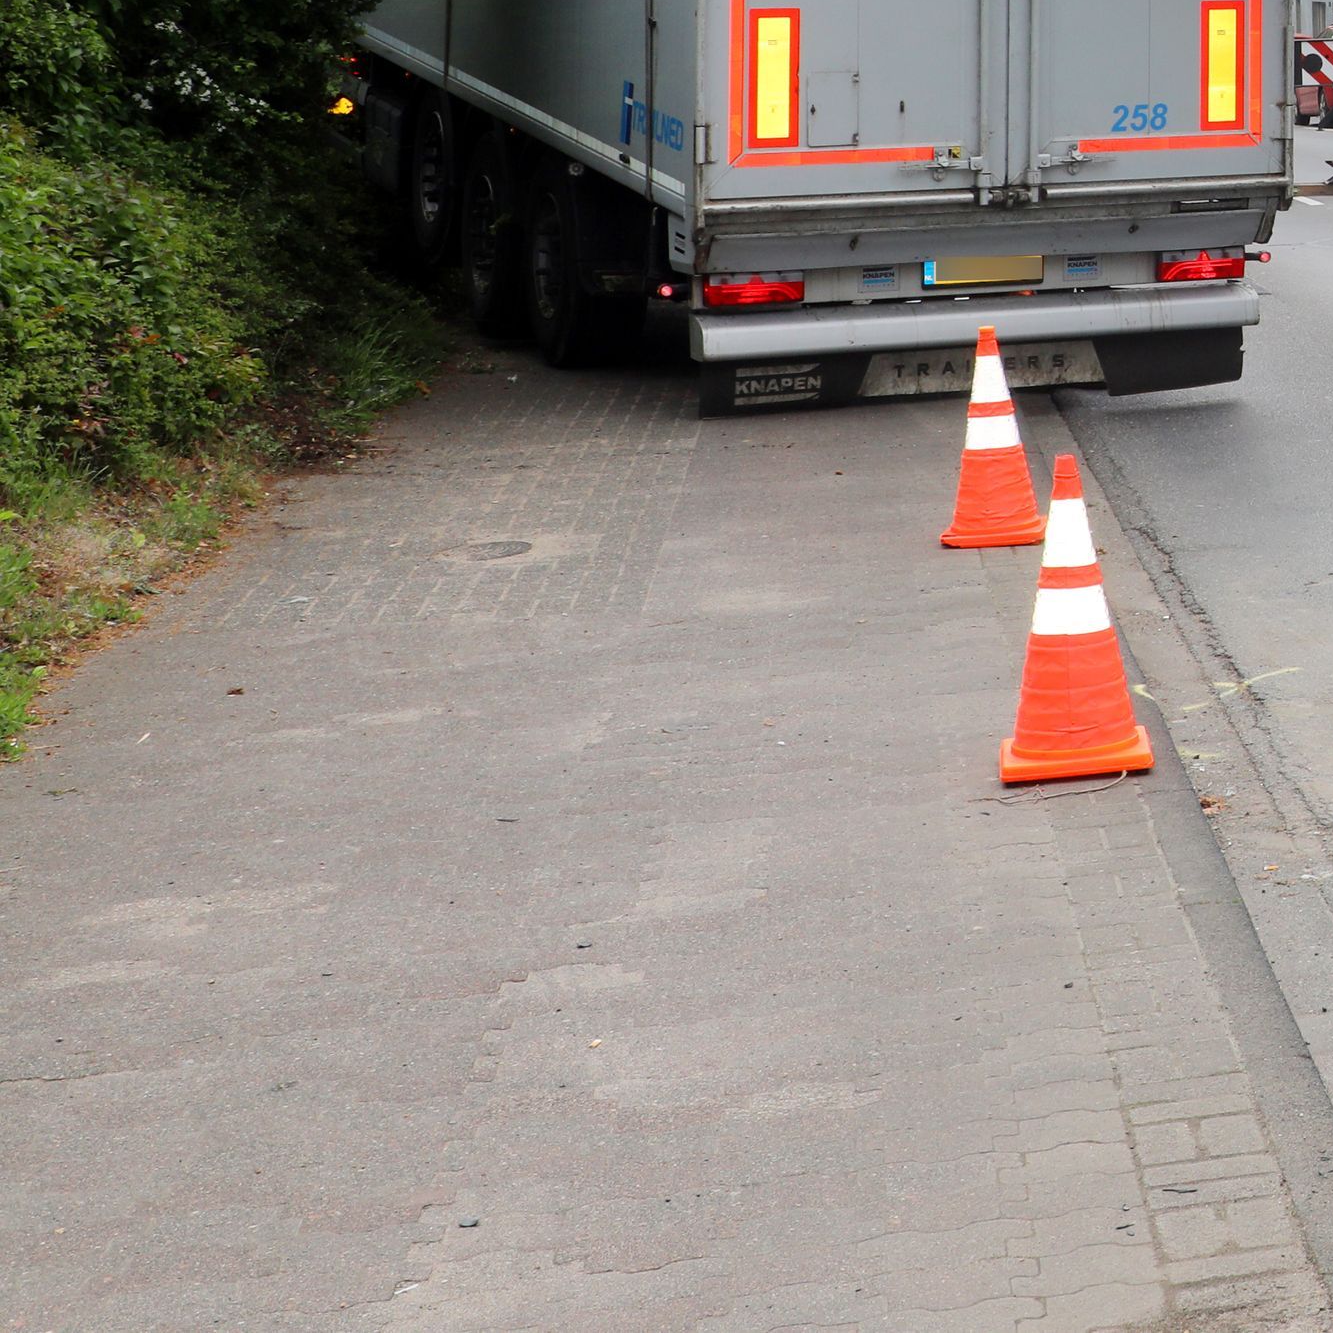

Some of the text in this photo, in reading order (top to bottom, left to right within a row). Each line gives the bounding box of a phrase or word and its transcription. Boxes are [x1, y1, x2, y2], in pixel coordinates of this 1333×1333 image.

[1111, 103, 1168, 132] 258
[1067, 259, 1098, 268] KNAPEN
[863, 271, 895, 279] KNAPEN
[924, 274, 934, 282] NL
[896, 353, 1066, 378] TRAIERS
[734, 375, 822, 396] KNAPEN
